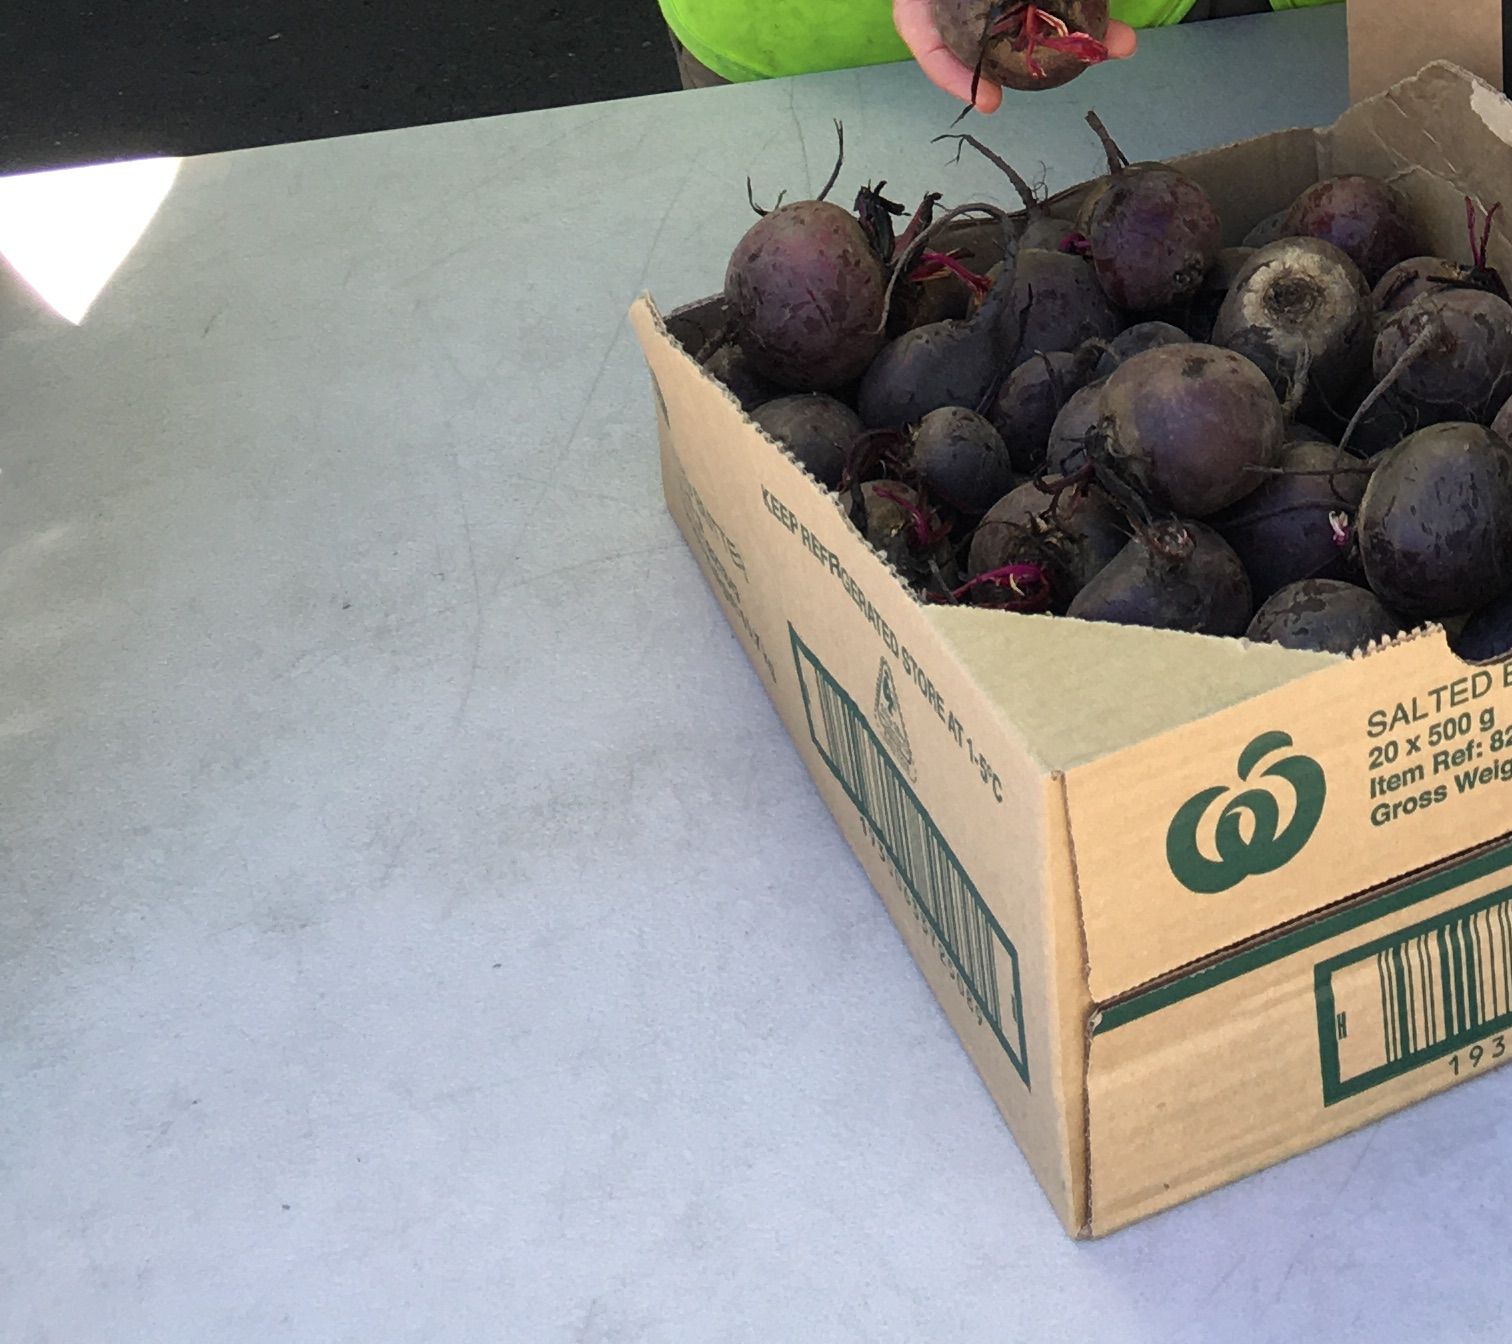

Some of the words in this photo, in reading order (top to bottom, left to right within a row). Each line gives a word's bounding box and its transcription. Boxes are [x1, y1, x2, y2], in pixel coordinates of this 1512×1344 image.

[761, 483, 799, 536] KEEP
[801, 522, 900, 659] REFRIGERATED
[901, 645, 946, 724] STORE
[948, 710, 964, 748] AT
[1366, 670, 1492, 739] SALTED
[1368, 742, 1398, 771] 20
[1406, 736, 1422, 754] x
[1427, 712, 1473, 748] 500
[1479, 706, 1496, 732] g
[1369, 769, 1425, 799] Item
[1432, 739, 1484, 775] Ref:
[1370, 786, 1448, 828] Gross
